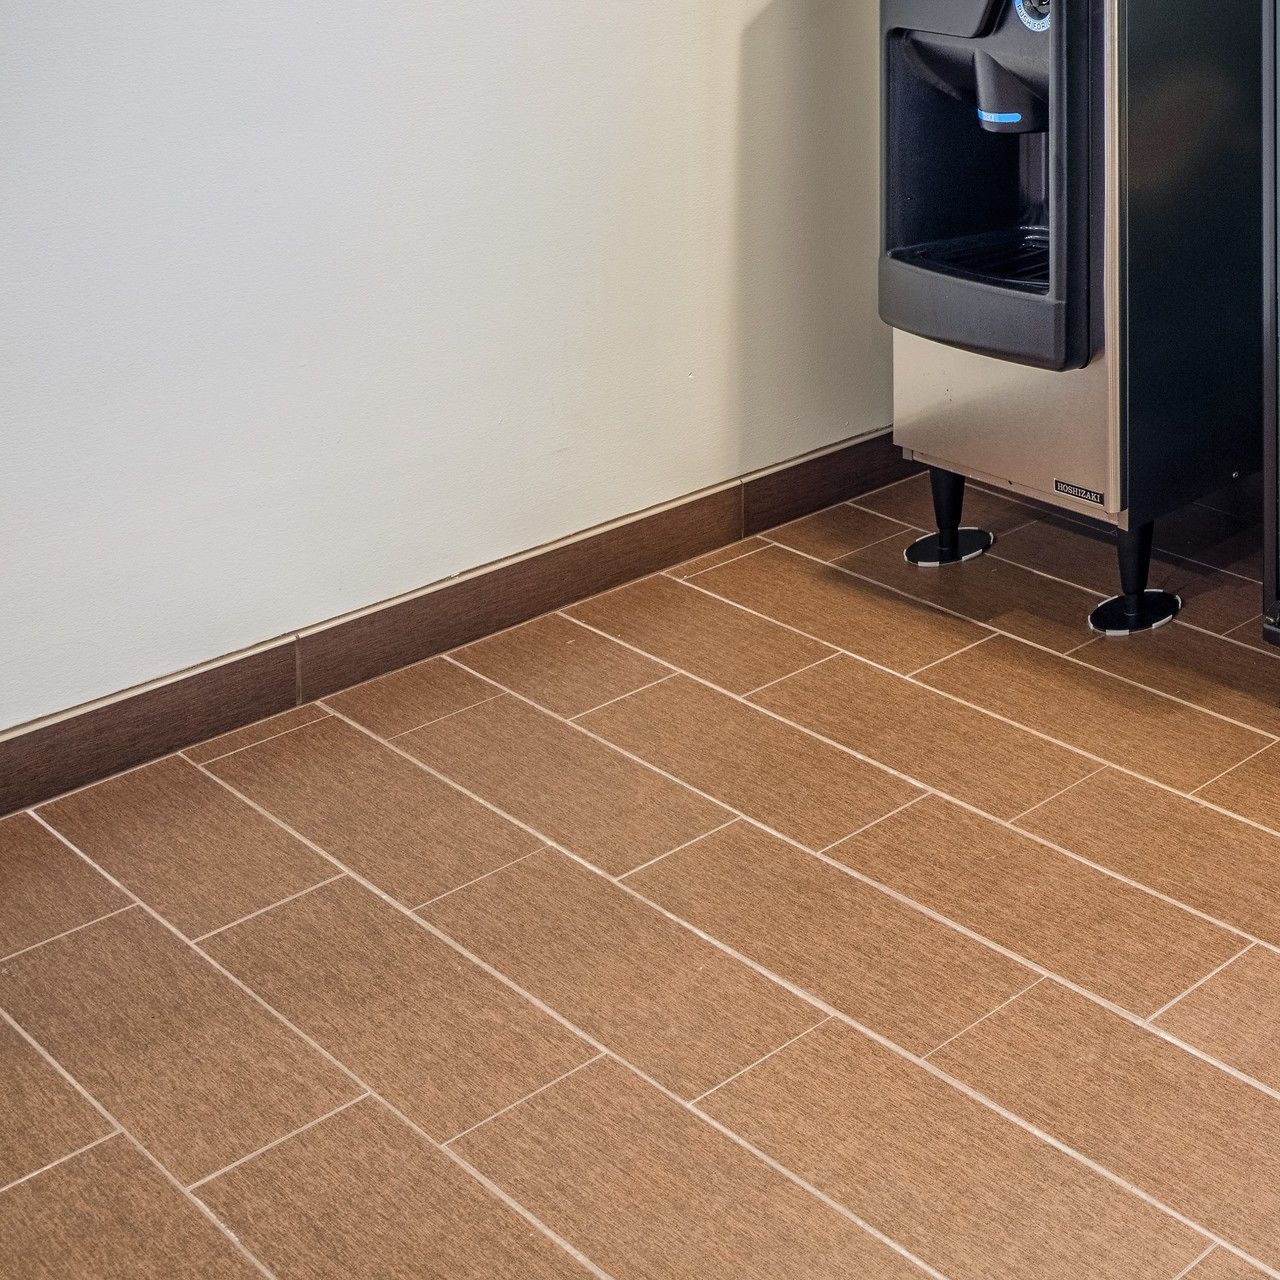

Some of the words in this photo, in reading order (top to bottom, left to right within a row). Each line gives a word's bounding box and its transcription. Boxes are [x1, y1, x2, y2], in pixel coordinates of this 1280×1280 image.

[1016, 4, 1032, 26] PUSH
[1033, 23, 1045, 31] FOR
[1057, 482, 1100, 502] HOSHIZAKI
